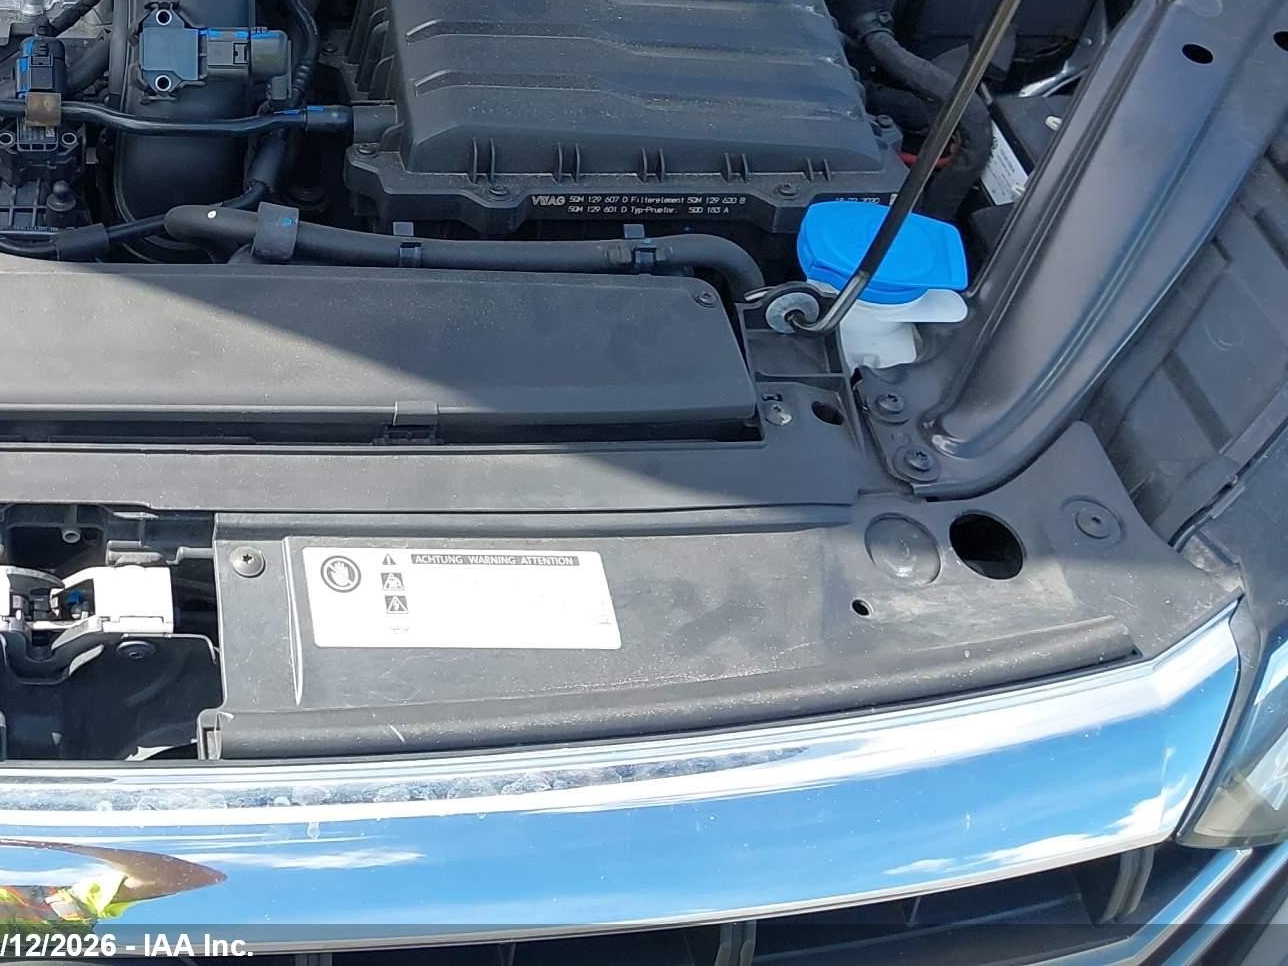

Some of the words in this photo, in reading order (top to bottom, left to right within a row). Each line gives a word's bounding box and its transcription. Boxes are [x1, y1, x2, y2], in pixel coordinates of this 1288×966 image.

[588, 195, 603, 204] 129
[604, 195, 620, 204] 607
[621, 195, 629, 204] D
[630, 195, 685, 205] Filterelement
[705, 196, 721, 205] 129
[586, 205, 602, 214] 129
[620, 205, 628, 214] D
[722, 206, 730, 215] A
[415, 554, 464, 566] ACHTUNG
[468, 554, 517, 566] WARNING
[520, 555, 575, 567] ATTENTION
